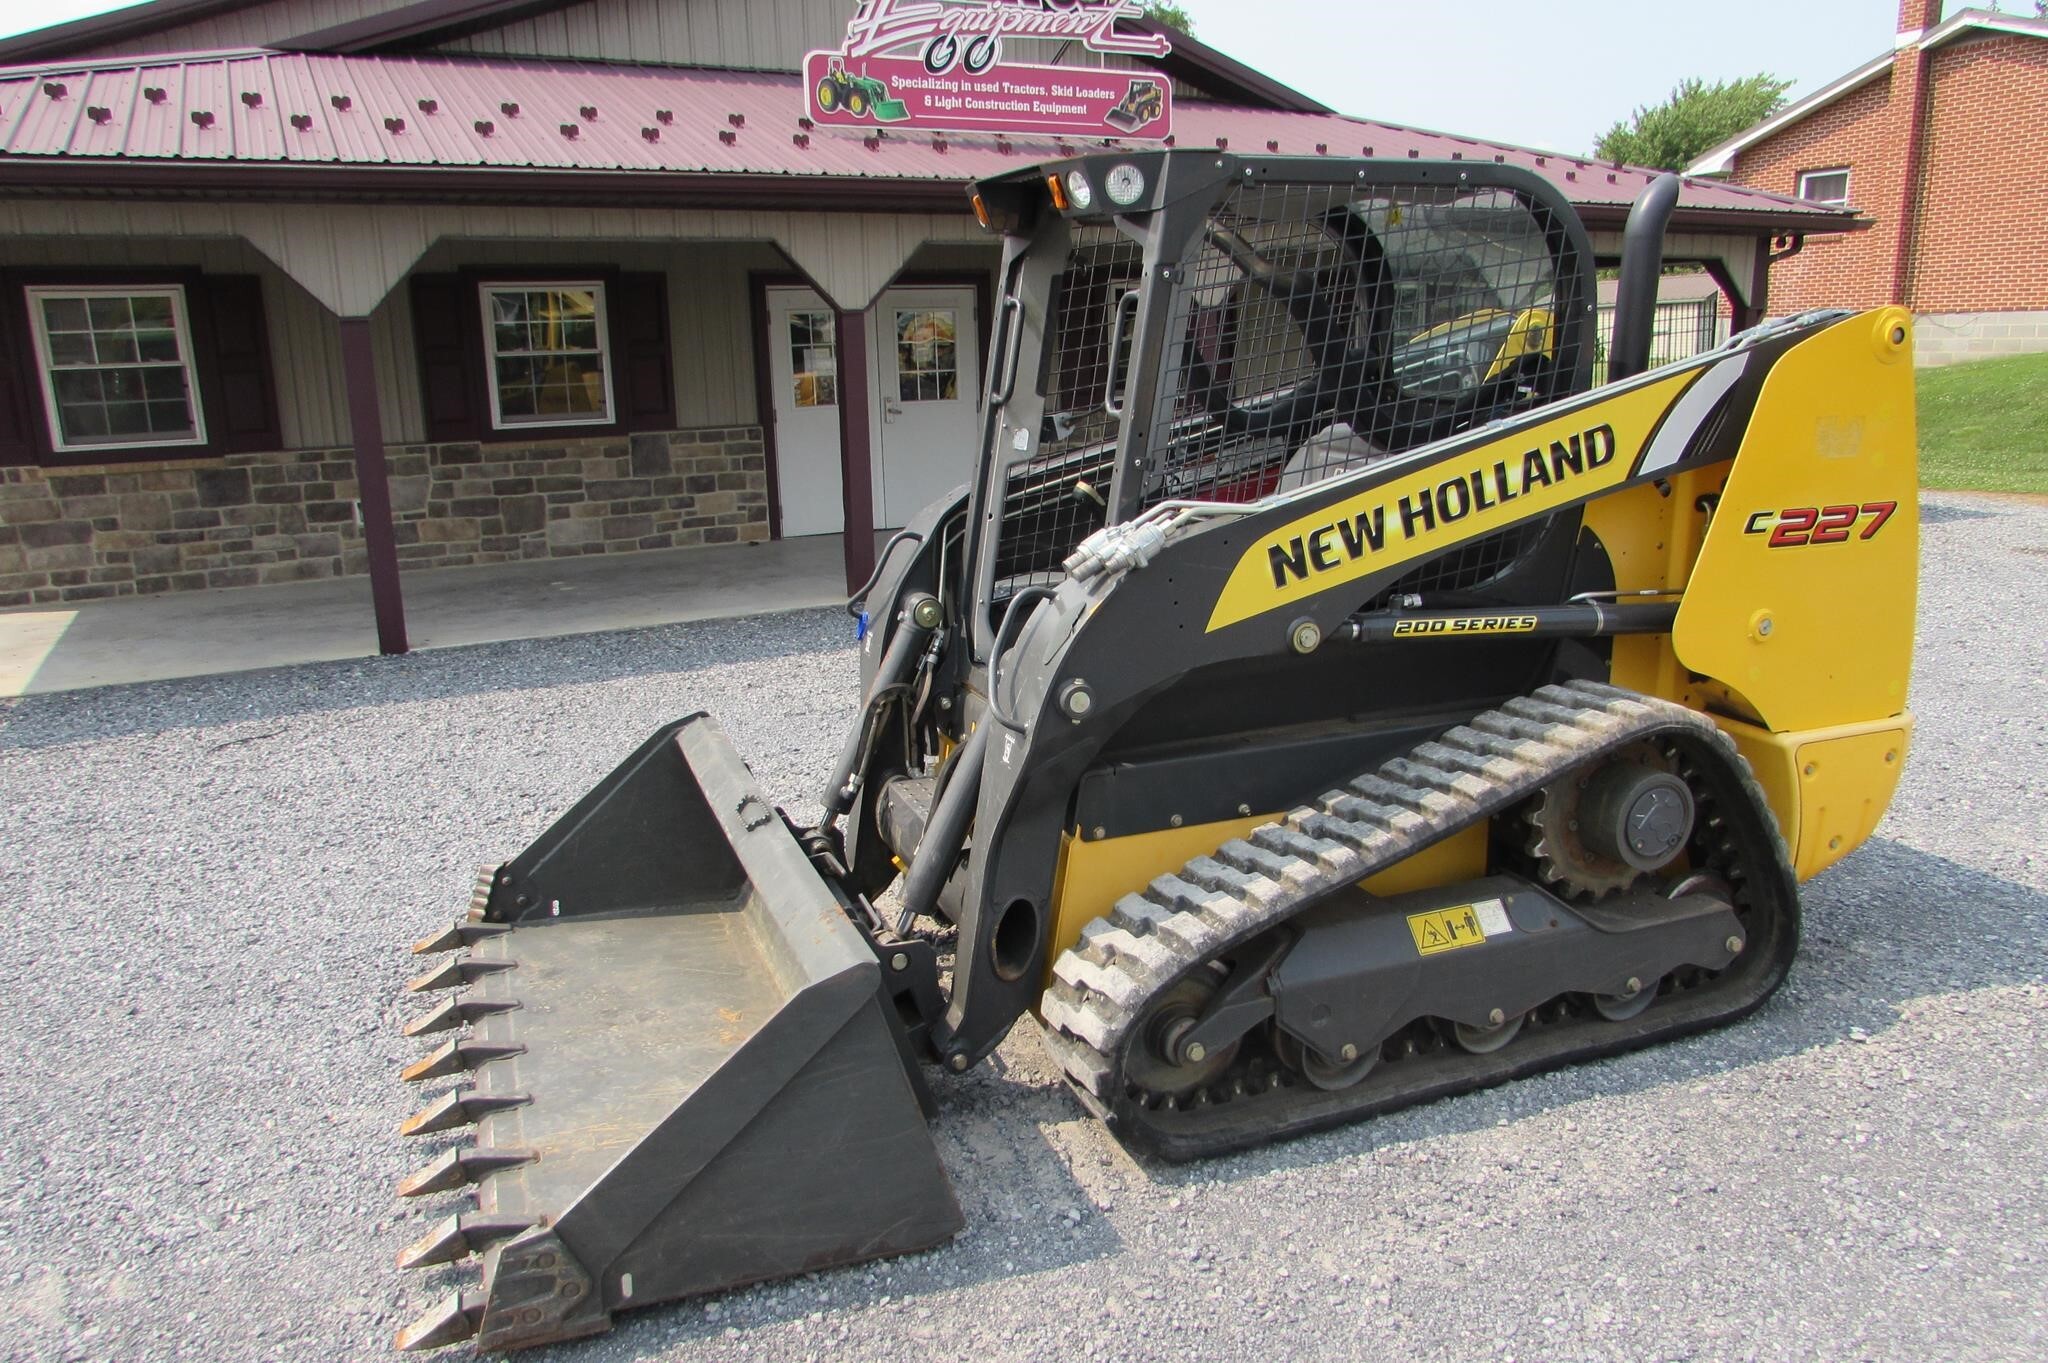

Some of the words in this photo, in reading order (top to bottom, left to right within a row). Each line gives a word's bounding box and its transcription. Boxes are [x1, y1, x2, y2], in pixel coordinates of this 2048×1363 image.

[851, 0, 1161, 63] Equipment
[891, 75, 959, 93] Specializing
[961, 80, 972, 92] in
[974, 81, 1000, 93] used
[1051, 85, 1073, 97] Skid
[1076, 86, 1115, 99] Loaders
[924, 94, 932, 106] &
[935, 95, 962, 109] Light
[965, 97, 1031, 112] Construction
[1033, 100, 1087, 115] Equipment
[1267, 504, 1386, 589] NEW
[1397, 423, 1616, 540] HOLLAND
[1744, 501, 1898, 548] C227
[1396, 620, 1446, 634] 200
[1452, 617, 1535, 631] SERIES
